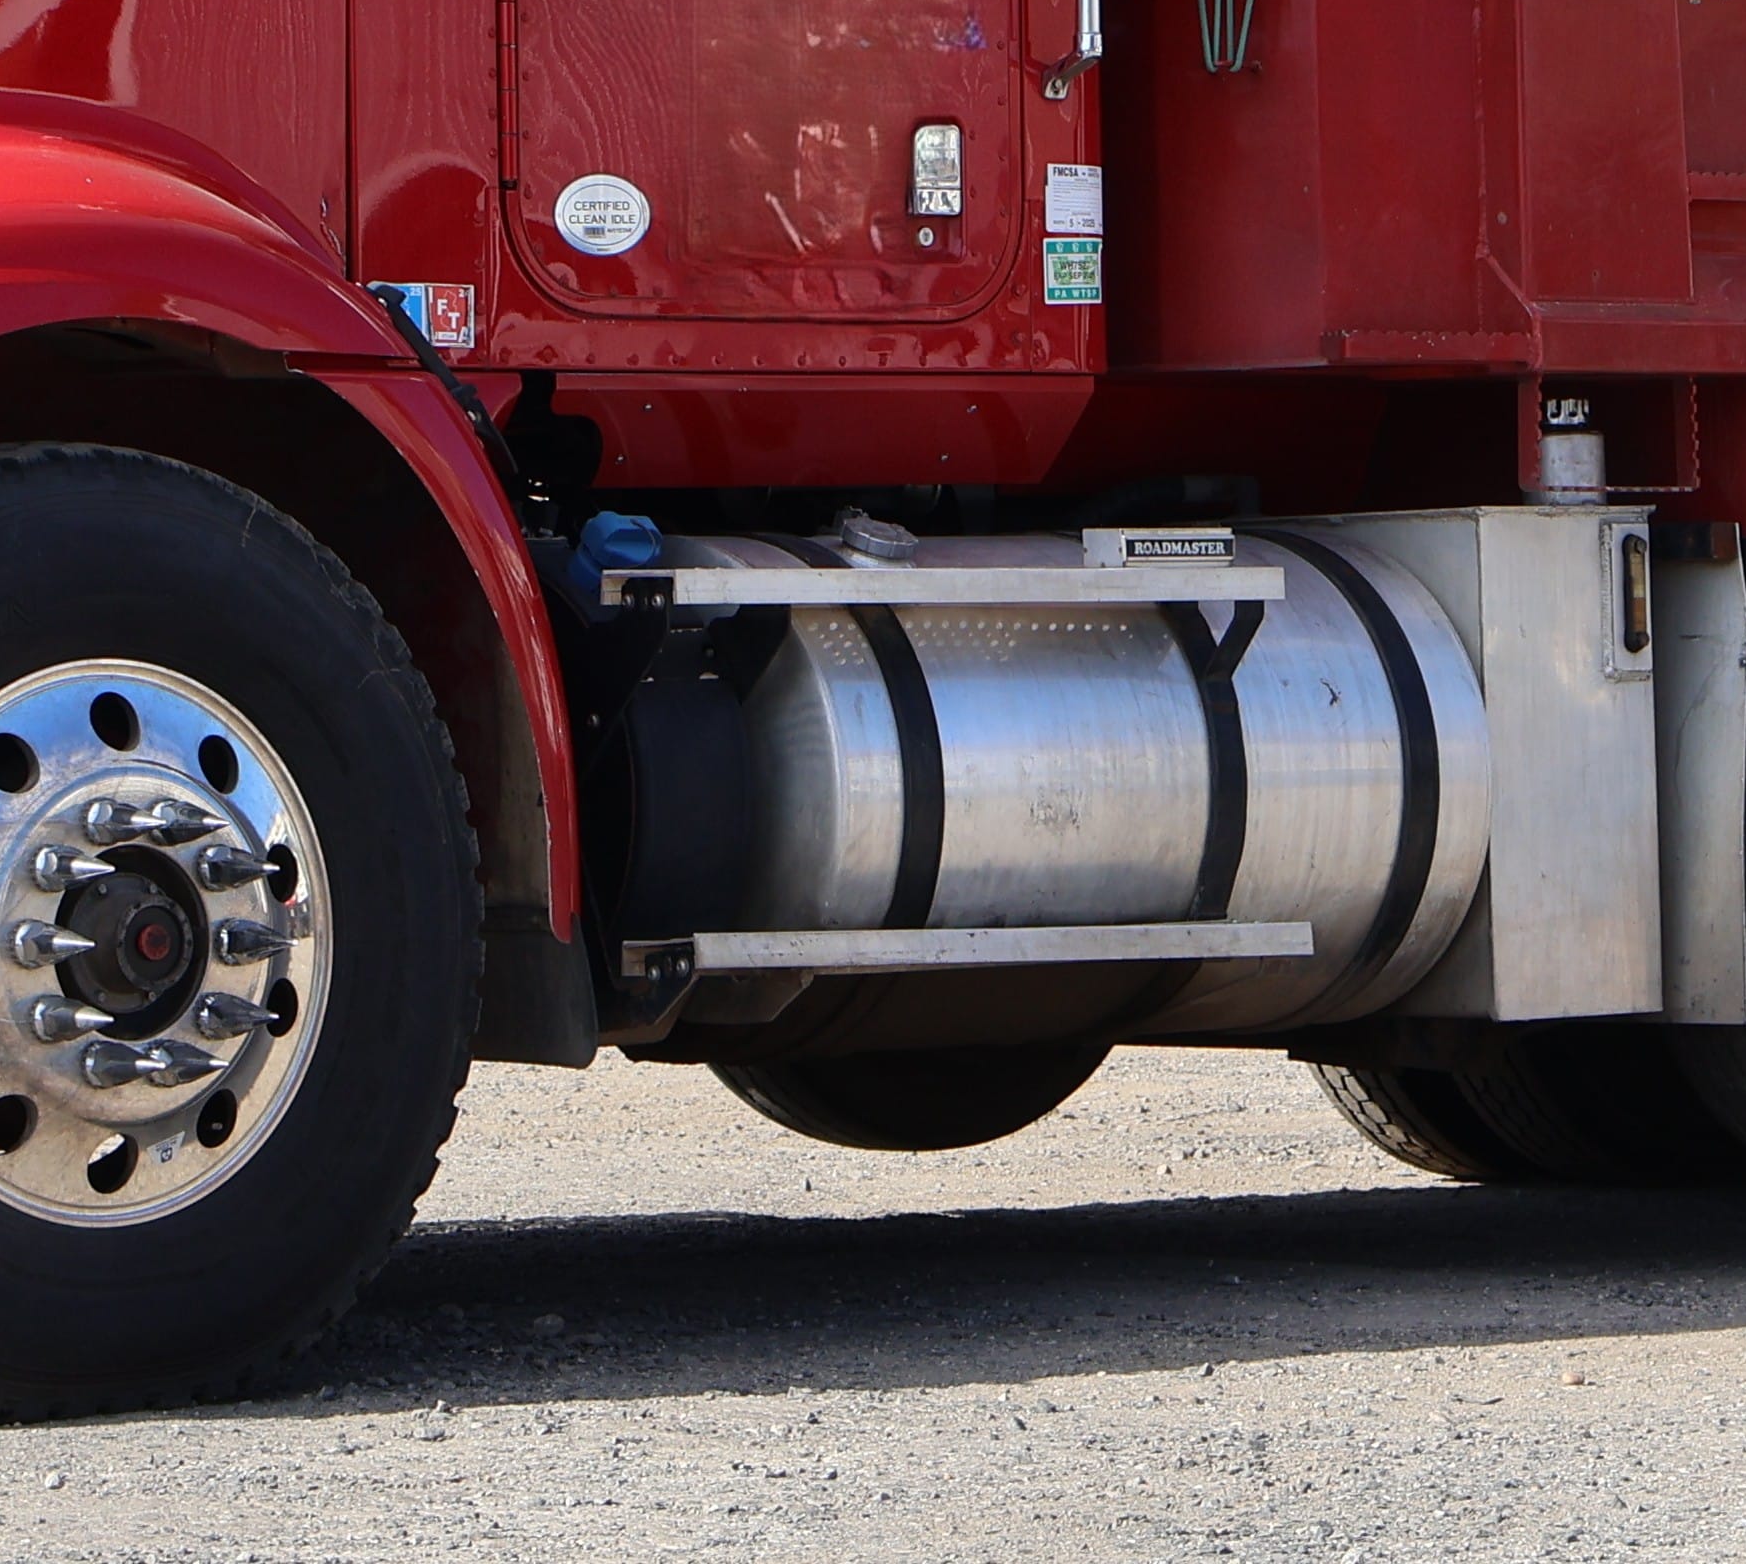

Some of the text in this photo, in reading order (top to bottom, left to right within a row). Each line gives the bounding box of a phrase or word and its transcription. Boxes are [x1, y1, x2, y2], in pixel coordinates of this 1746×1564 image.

[1053, 166, 1079, 177] FMCSA
[573, 201, 631, 212] CERTIFIED
[568, 215, 637, 225] CLEAN IDLE
[410, 287, 422, 297] 25
[1054, 289, 1067, 299] PA
[1134, 541, 1226, 555] ROADMASTER
